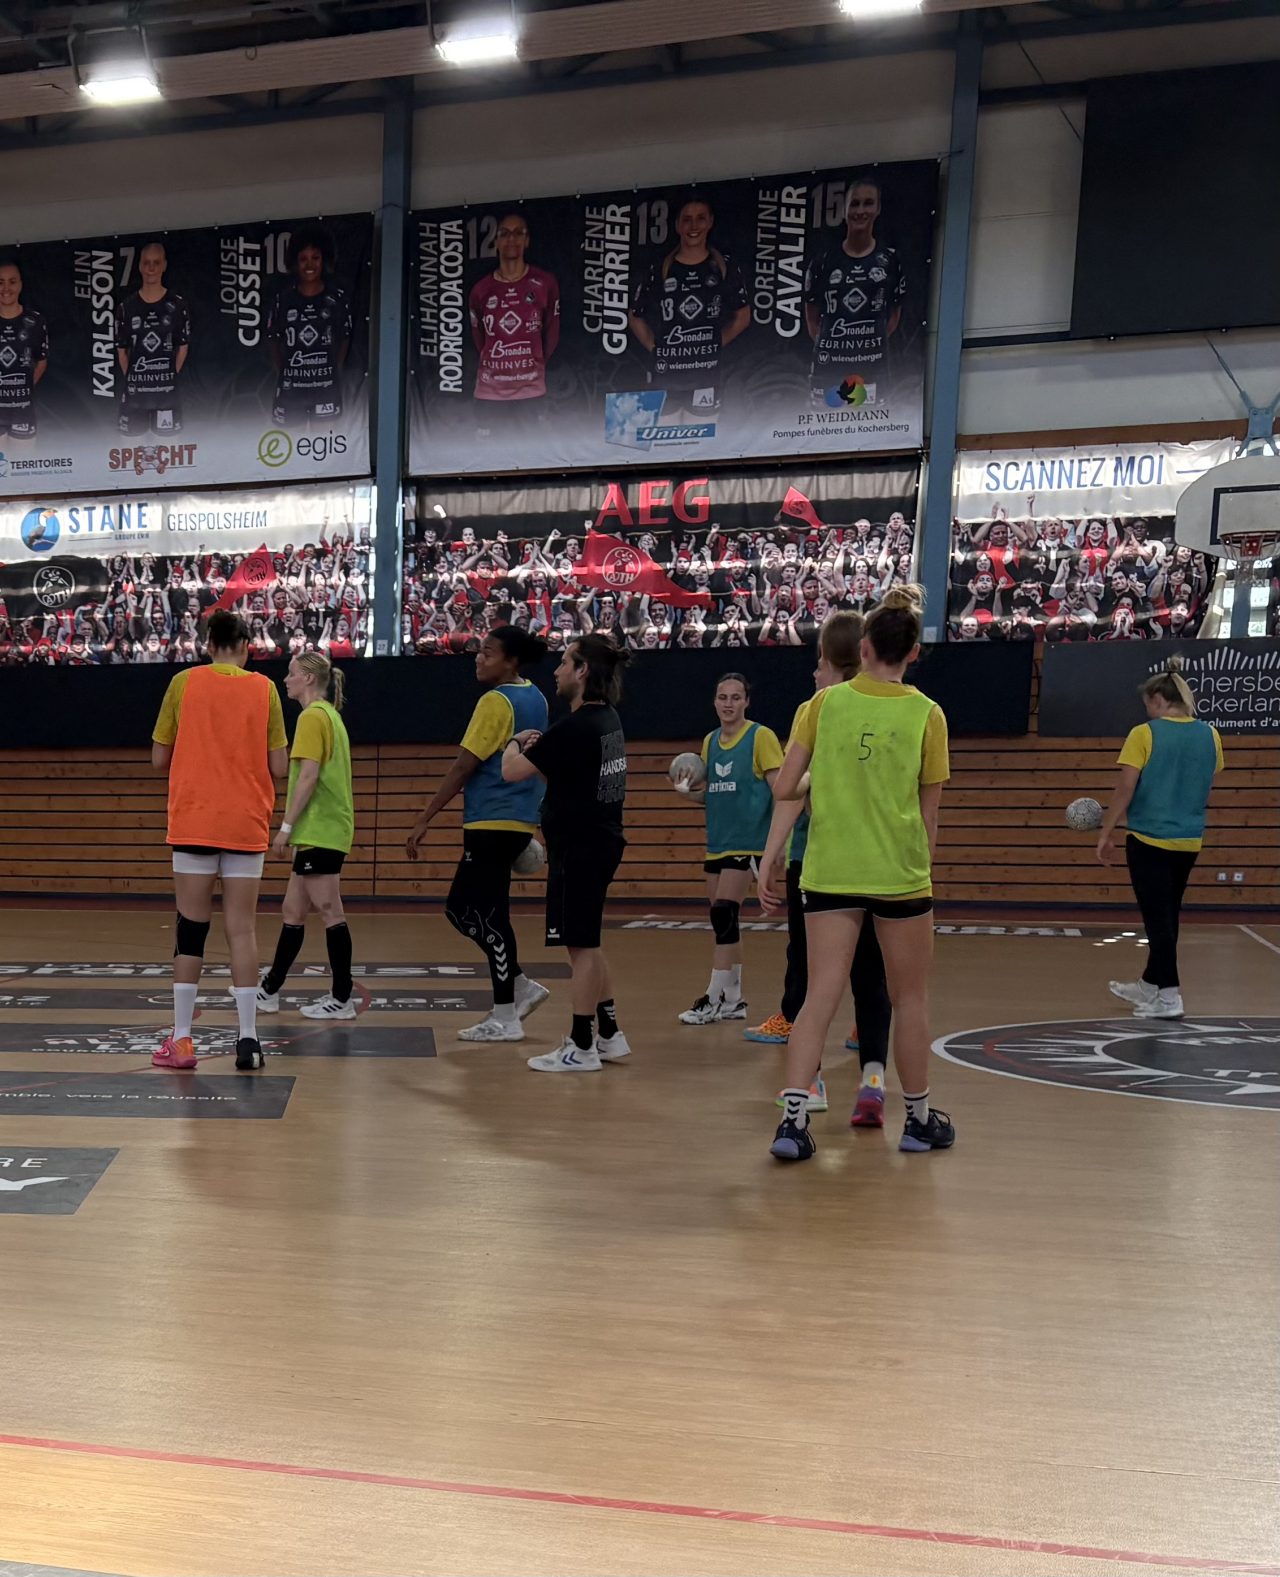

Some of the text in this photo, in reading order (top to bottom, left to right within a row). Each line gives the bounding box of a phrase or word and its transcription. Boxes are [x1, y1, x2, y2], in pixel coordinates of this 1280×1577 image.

[636, 201, 669, 246] 13
[811, 181, 846, 229] 15
[467, 215, 497, 260] 12
[753, 188, 778, 325] CORENTINE
[74, 250, 91, 299] ELIN
[120, 246, 135, 287] 7
[220, 237, 237, 315] LOUISE
[581, 205, 605, 334] CHARLÈNE
[602, 203, 631, 356] GUERRIER
[774, 185, 807, 339] CAVALIER
[238, 235, 261, 347] CUSSET
[419, 222, 438, 357] ELIHANNAH
[439, 219, 464, 393] RODRIGO DA COSTA
[91, 250, 115, 398] KARLSSON
[819, 337, 882, 350] EURINVEST
[656, 344, 718, 357] EURINVEST
[640, 425, 708, 441] Univer
[773, 422, 910, 440] Pompes funèbres du Kochersberg
[816, 409, 889, 424] WEIDMANN
[10, 457, 72, 470] TERRITOIRES
[296, 430, 347, 462] egis
[985, 454, 1164, 491] SCANNEZ MOI
[68, 502, 268, 534] STANE GEISPOLSHEIM
[595, 477, 710, 526] AEG
[858, 732, 874, 761] 5
[708, 779, 737, 793] erima
